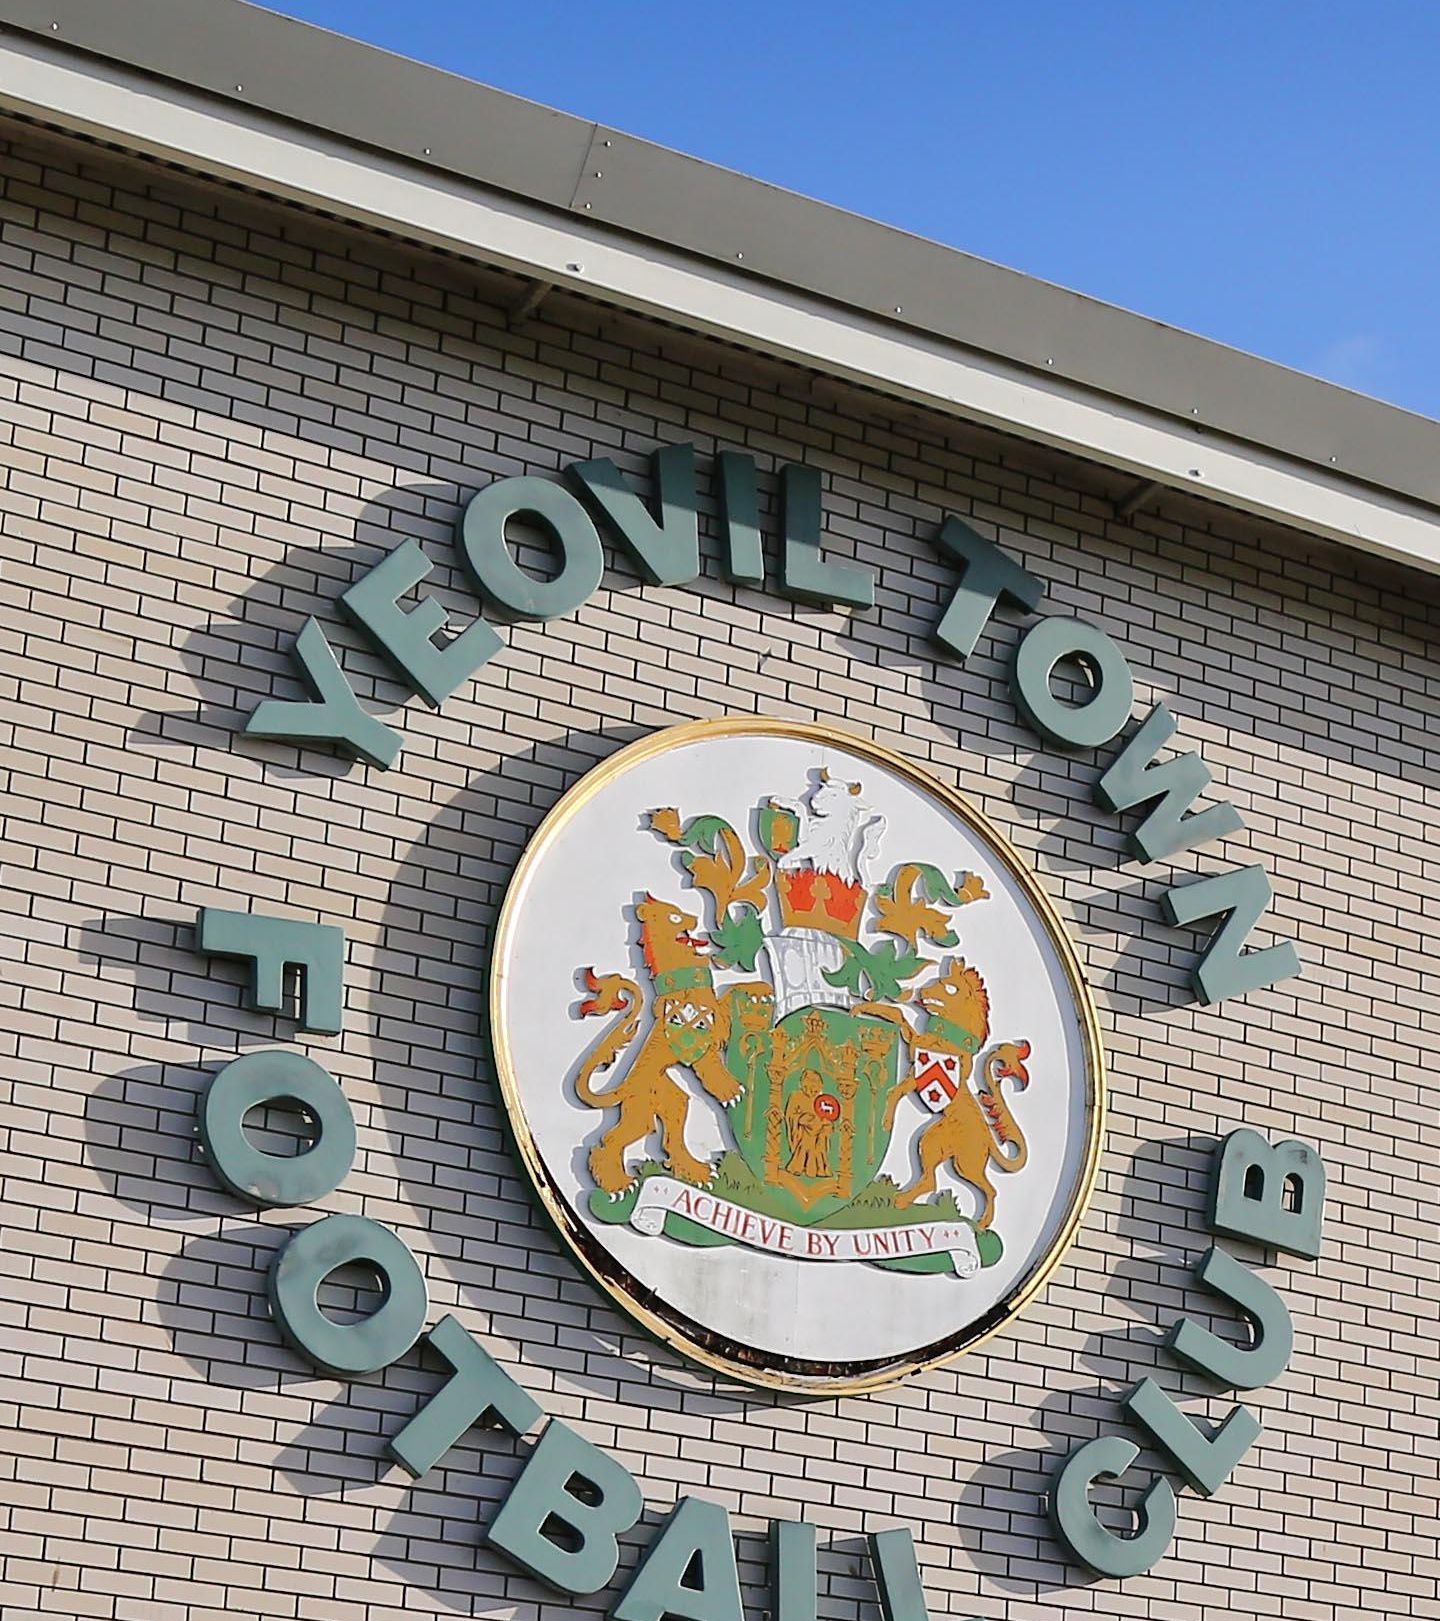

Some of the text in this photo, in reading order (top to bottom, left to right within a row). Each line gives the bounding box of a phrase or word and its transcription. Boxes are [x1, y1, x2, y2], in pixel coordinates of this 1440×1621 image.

[244, 443, 1306, 1008] YEOVIL TOWN
[671, 1187, 936, 1257] ACHIEVE BY UNITY
[1046, 1126, 1328, 1580] CLUB
